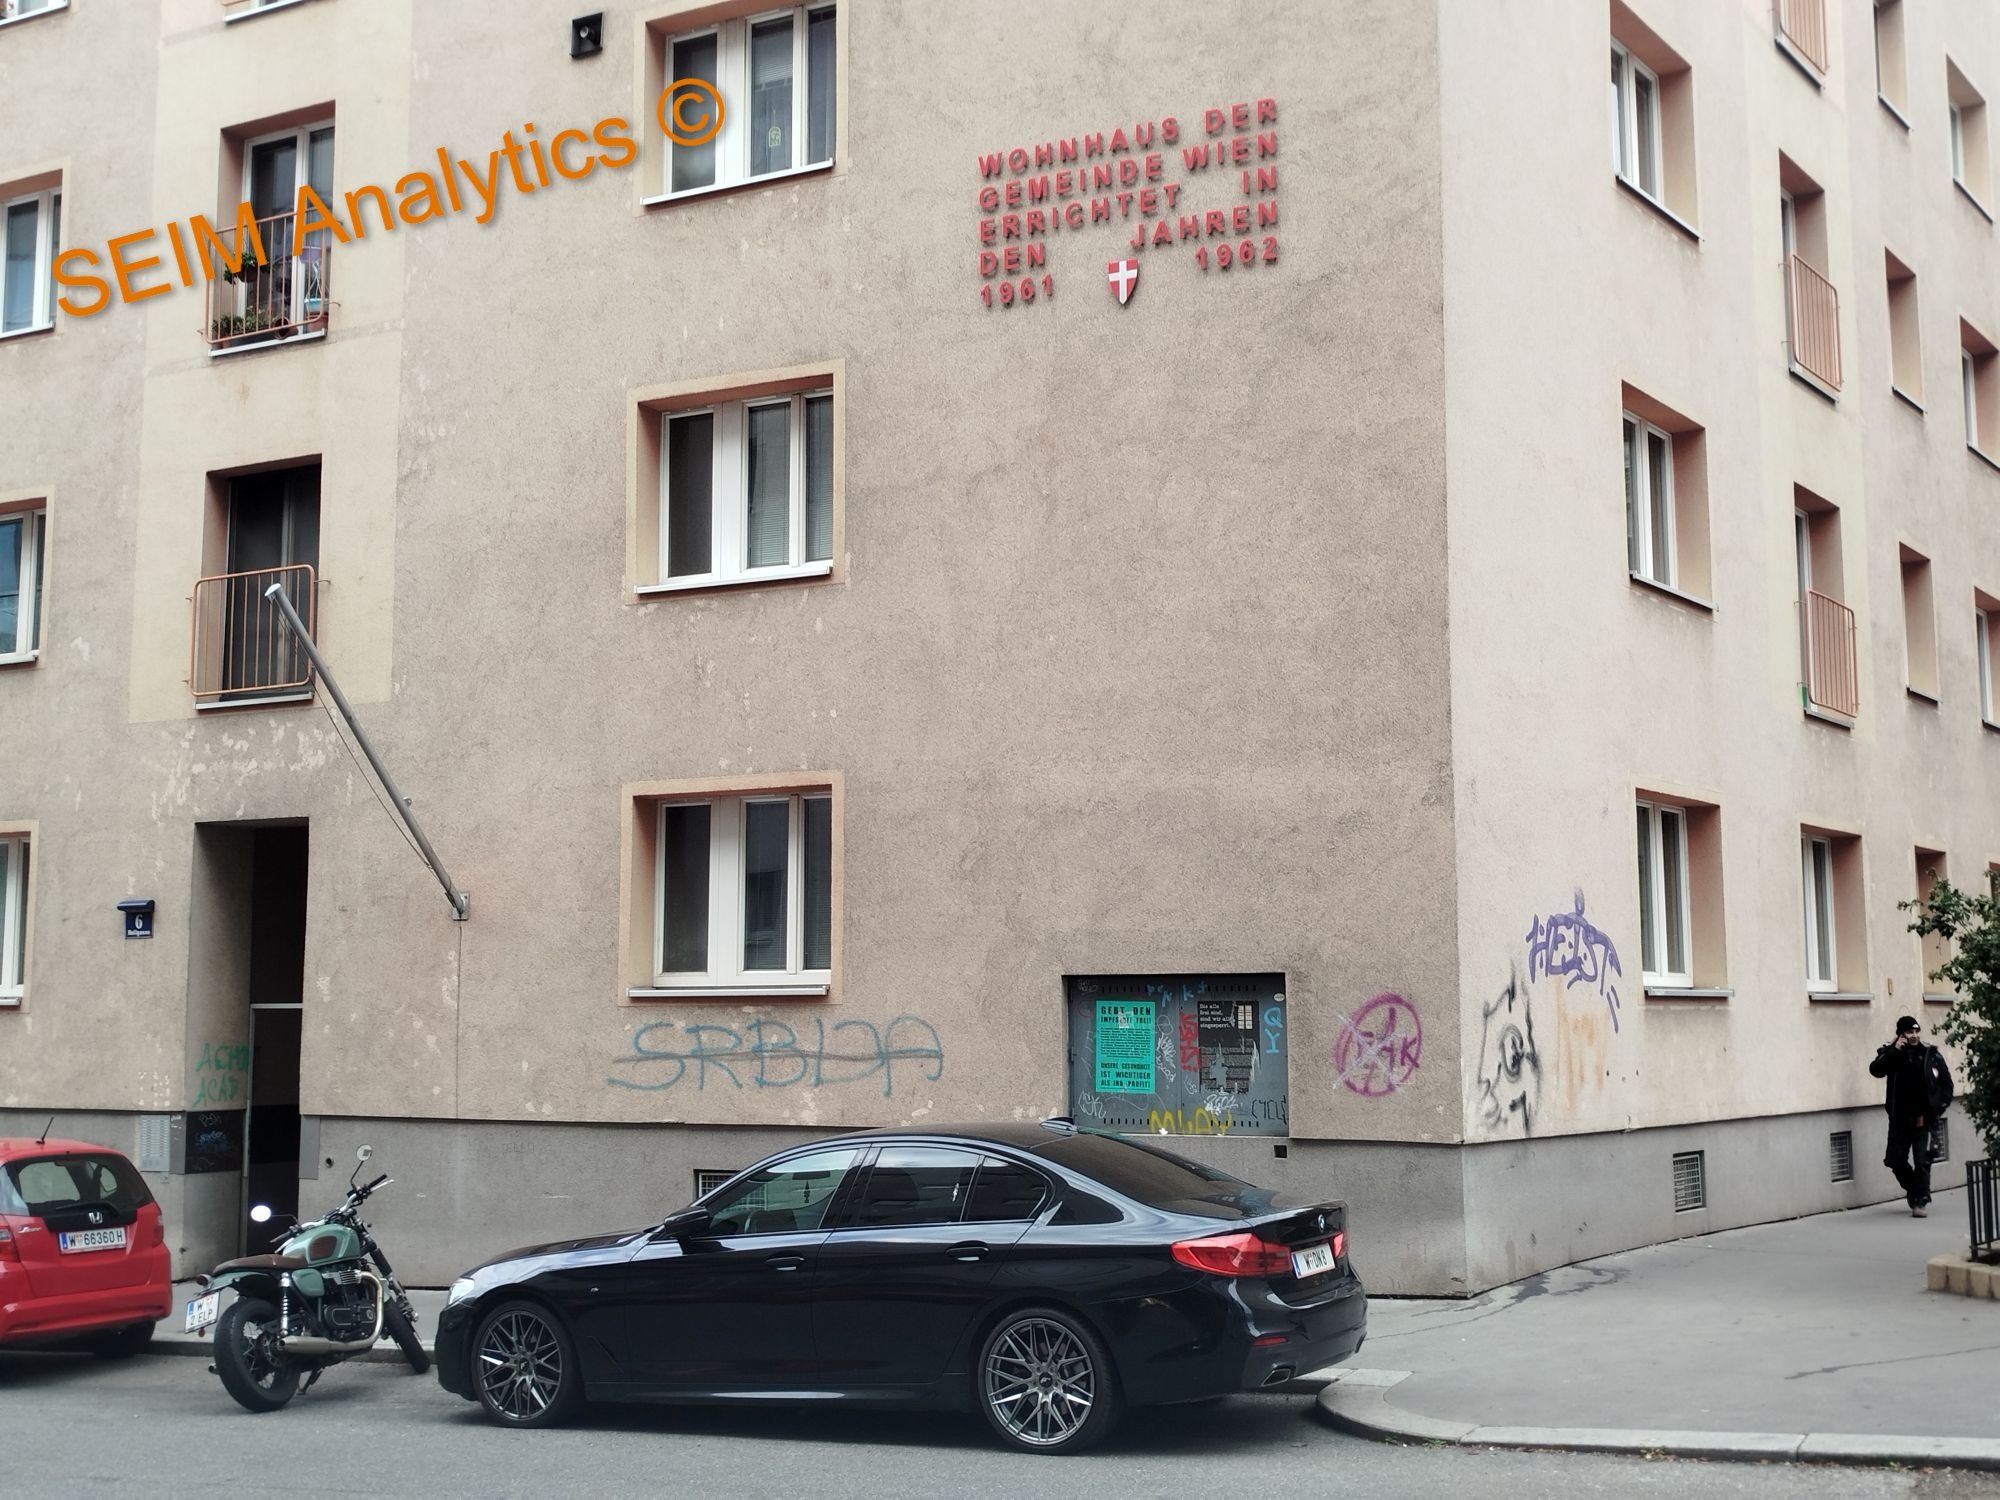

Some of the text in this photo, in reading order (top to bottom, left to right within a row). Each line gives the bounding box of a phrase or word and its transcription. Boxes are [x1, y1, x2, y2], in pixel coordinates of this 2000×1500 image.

[978, 97, 1277, 178] WOHNHAUS DER
[978, 131, 1277, 210] GEMEINDE WIEN
[979, 165, 1277, 242] ERRICHTET IN
[979, 200, 1277, 276] DEN JAHREN
[980, 235, 1278, 307] 1961 1962
[135, 914, 143, 930] 6
[1101, 1006, 1151, 1015] GEBT DEN
[1115, 1071, 1151, 1079] WICHTIGER
[68, 1230, 123, 1246] W 66360 H
[197, 1300, 204, 1311] W
